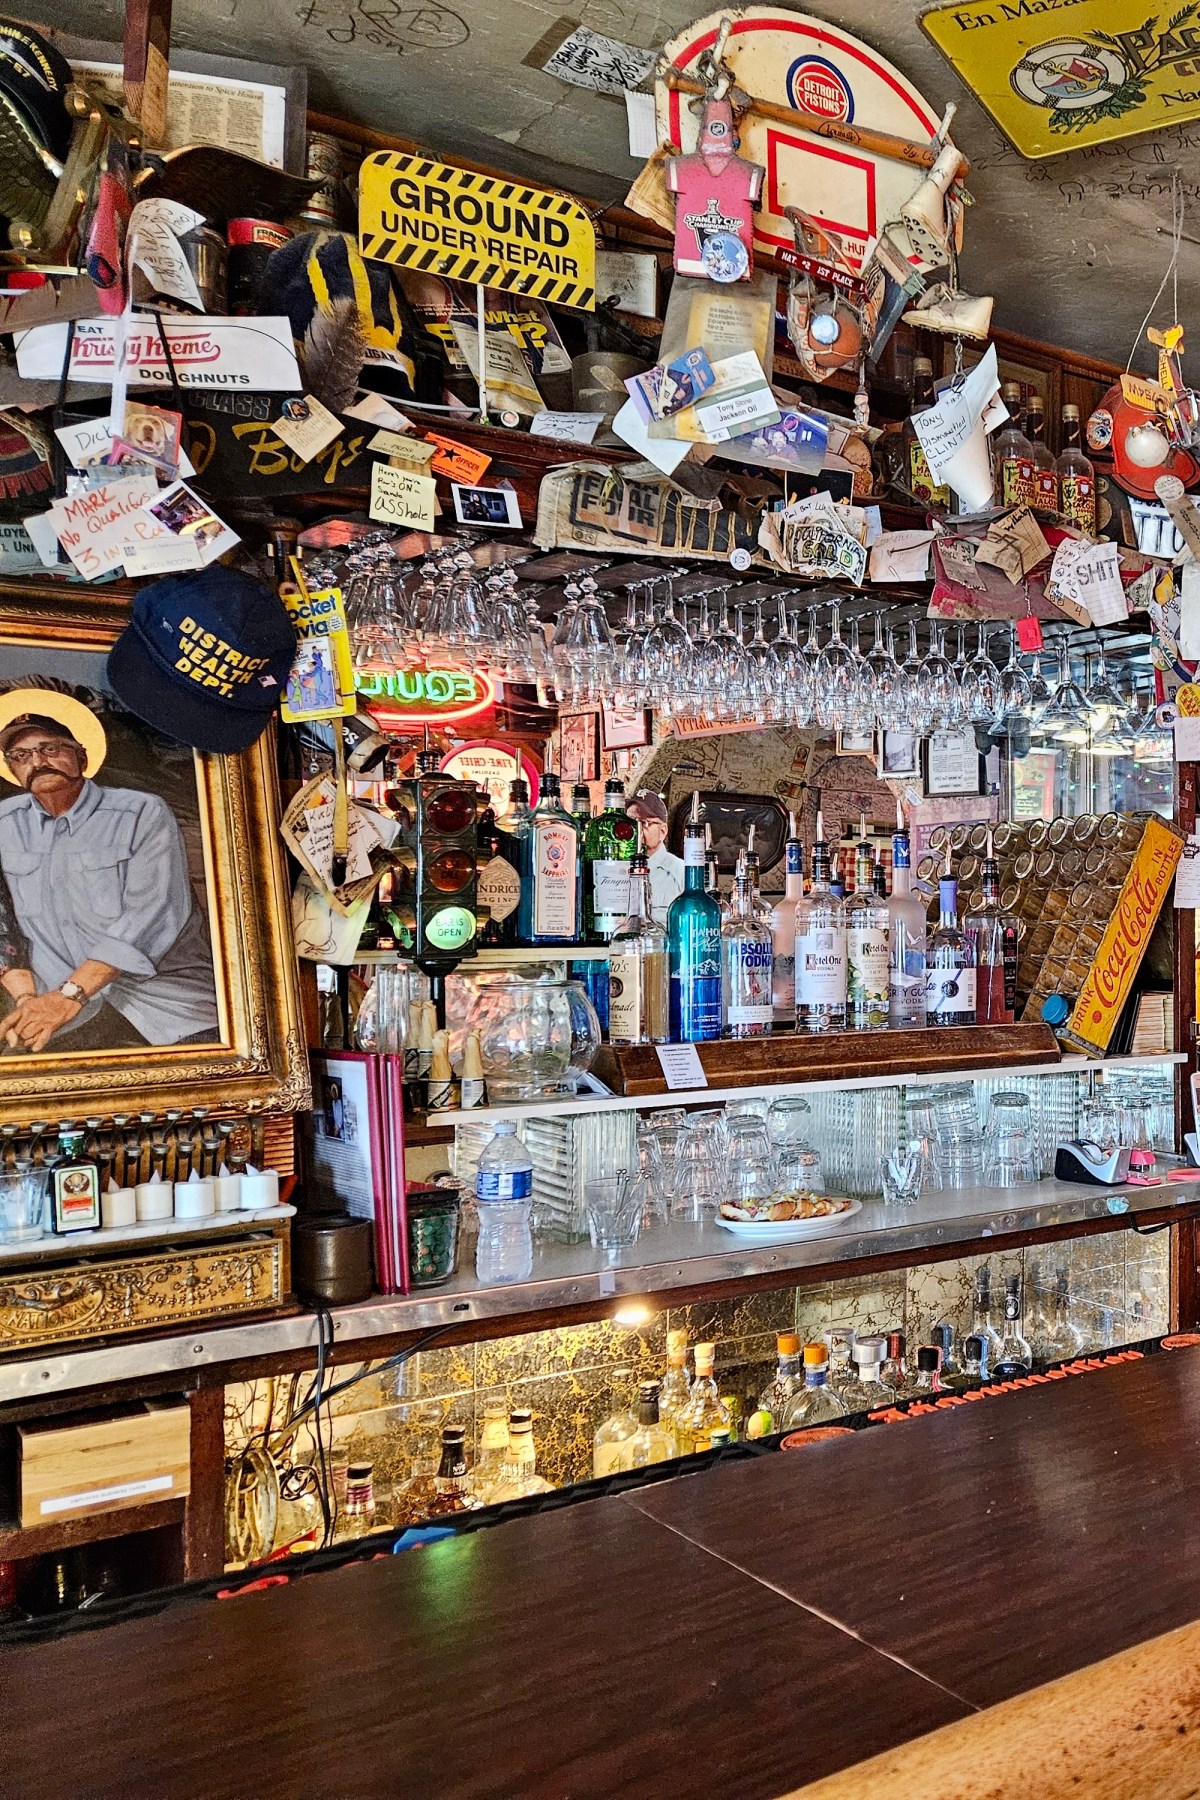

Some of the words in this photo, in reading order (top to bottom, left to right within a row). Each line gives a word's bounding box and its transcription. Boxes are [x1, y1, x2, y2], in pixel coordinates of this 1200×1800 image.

[953, 9, 1004, 34] En
[803, 78, 841, 101] DETROIT
[803, 90, 841, 115] PISTONS
[389, 178, 571, 248] GROUND
[685, 214, 722, 226] STANLEY
[722, 216, 744, 226] CUP
[380, 211, 480, 254] UNDER
[486, 240, 580, 279] REPAIR
[817, 267, 830, 278] 1ST
[831, 272, 854, 287] PLACE
[484, 310, 540, 325] What
[77, 326, 104, 335] EAT
[138, 369, 251, 386] DOUGHNUTS
[925, 432, 965, 461] CLINT
[455, 457, 480, 472] OFFICER
[63, 487, 116, 524] MARK
[1076, 557, 1117, 586] SHIT
[178, 616, 270, 671] DISTRICT
[177, 636, 254, 685] HEALTH
[174, 656, 238, 699] DEPT.
[543, 830, 571, 843] BOMBAY
[1151, 849, 1164, 865] IN
[1155, 837, 1180, 886] BOTTLES
[540, 866, 571, 877] SAPPHIRE
[437, 928, 463, 938] OPEN
[1092, 867, 1158, 1009] Coca-Cola
[828, 956, 842, 966] One
[1072, 986, 1095, 1031] DRINK
